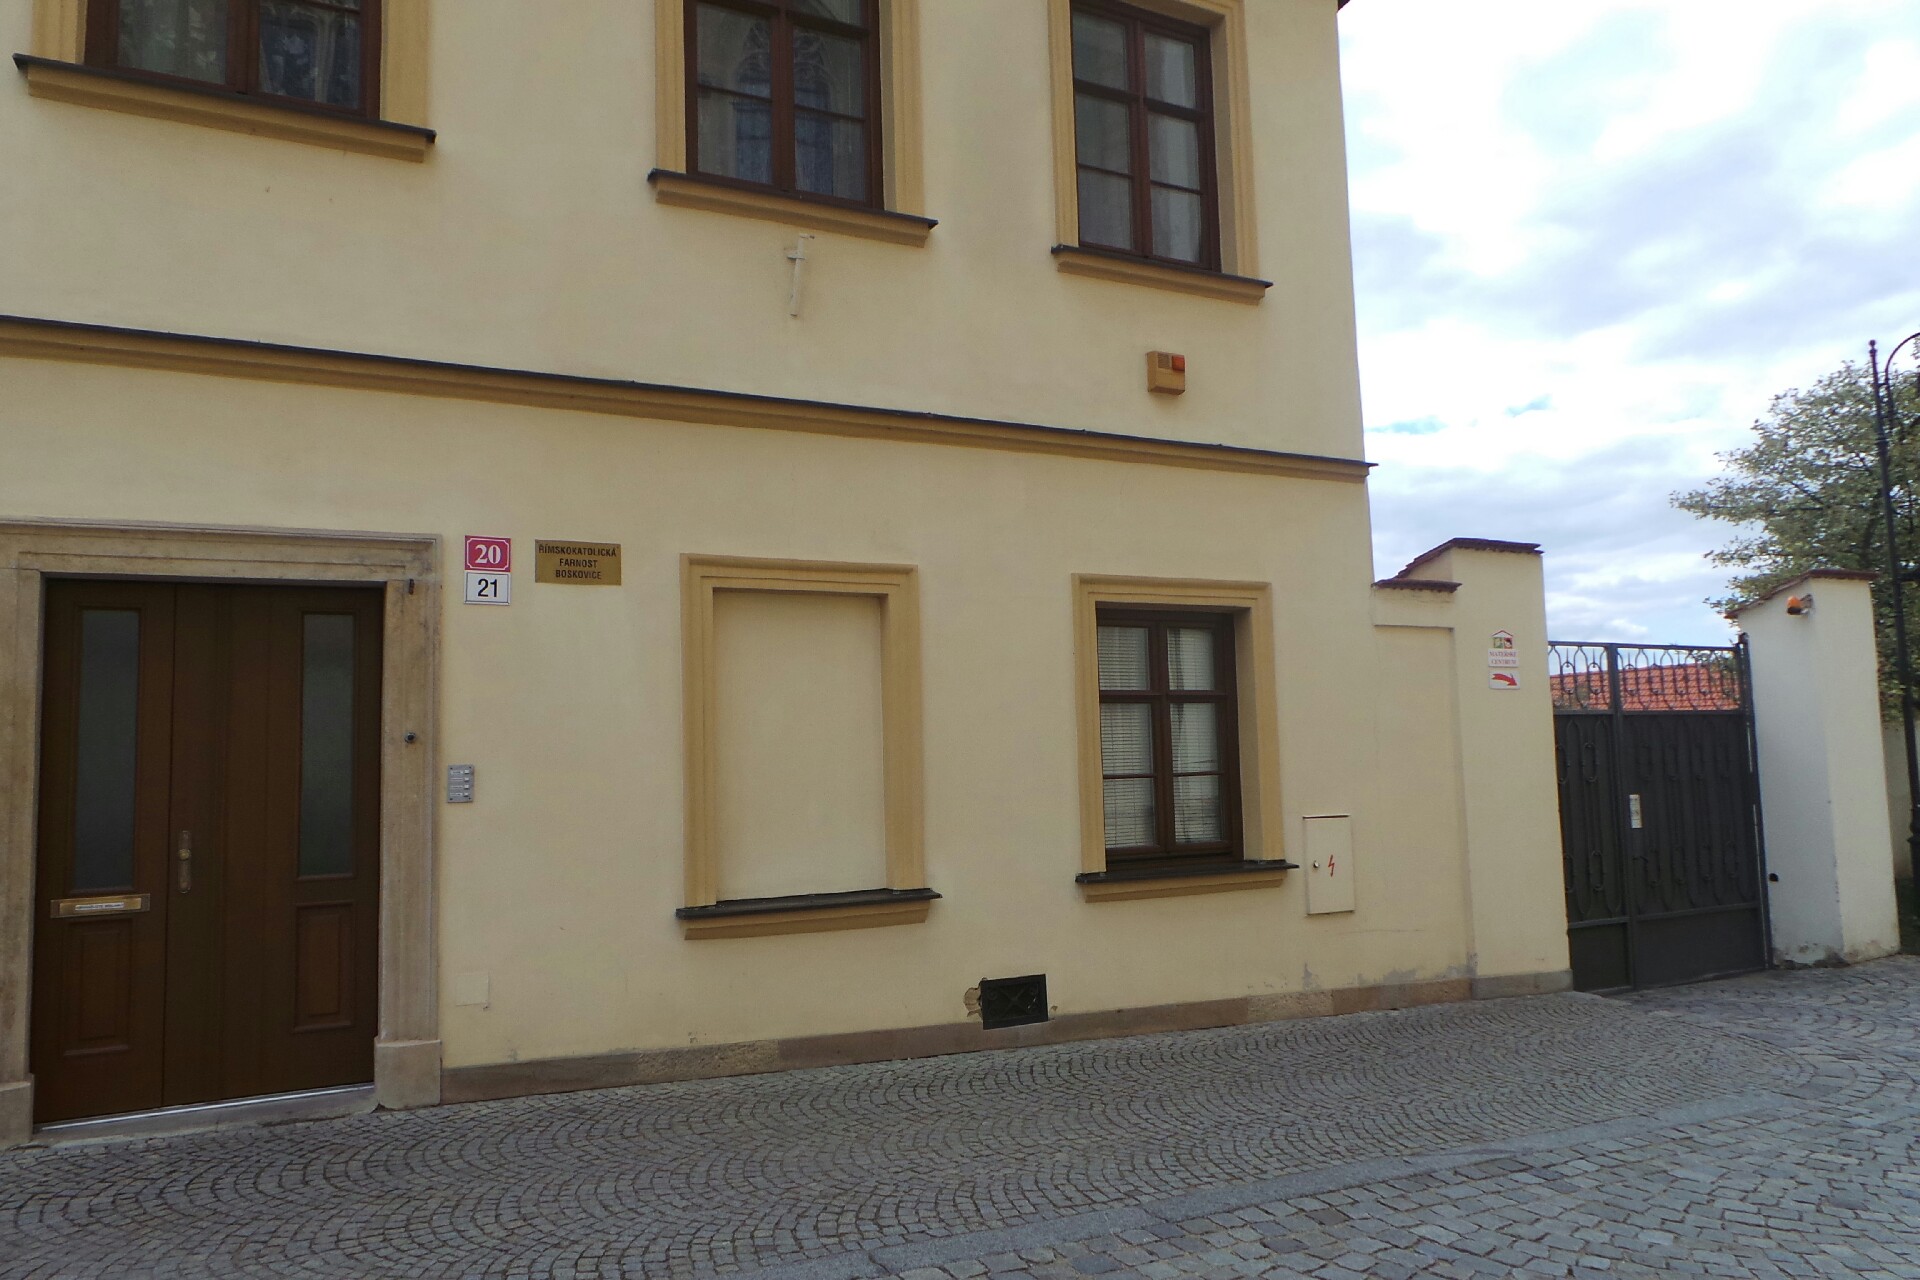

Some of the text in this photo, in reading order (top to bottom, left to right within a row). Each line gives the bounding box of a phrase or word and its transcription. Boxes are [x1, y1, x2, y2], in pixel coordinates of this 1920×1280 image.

[475, 544, 501, 564] 20
[559, 558, 599, 569] FARNOST
[555, 570, 602, 580] BOSKOVICE
[477, 578, 498, 598] 21
